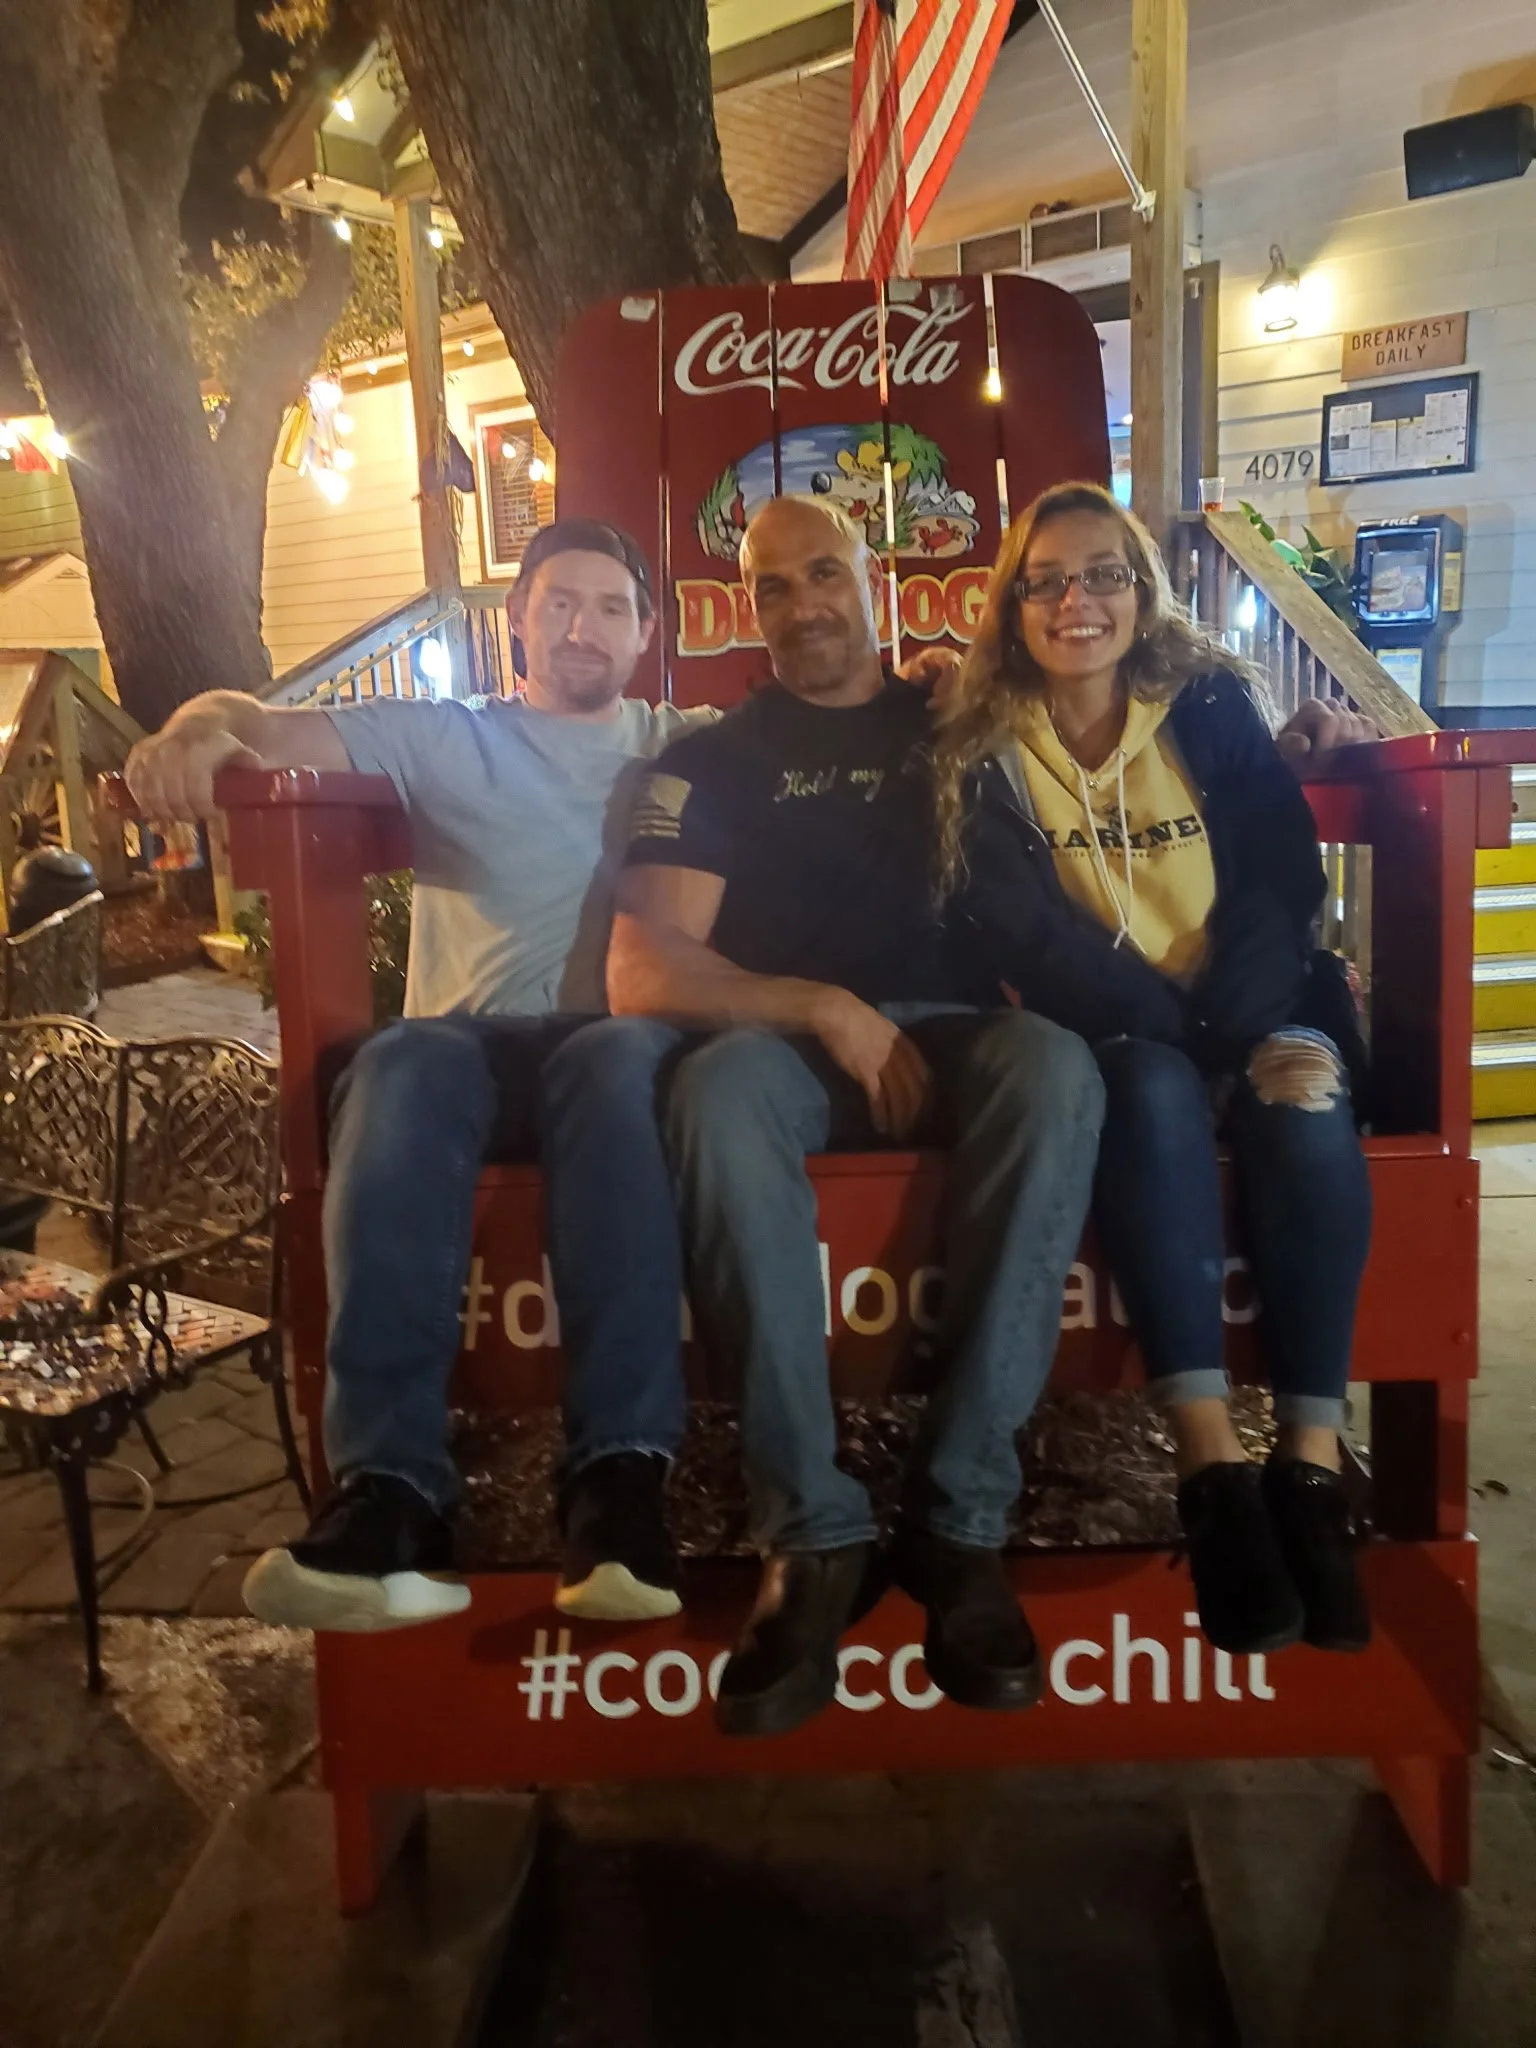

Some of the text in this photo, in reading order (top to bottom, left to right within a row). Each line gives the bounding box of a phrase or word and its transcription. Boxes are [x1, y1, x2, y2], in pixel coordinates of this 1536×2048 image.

[674, 302, 975, 396] Coca-Cola
[1352, 320, 1456, 351] BREAKFAST
[1376, 344, 1427, 366] DAILY
[1246, 450, 1314, 480] 4079
[849, 769, 885, 803] my
